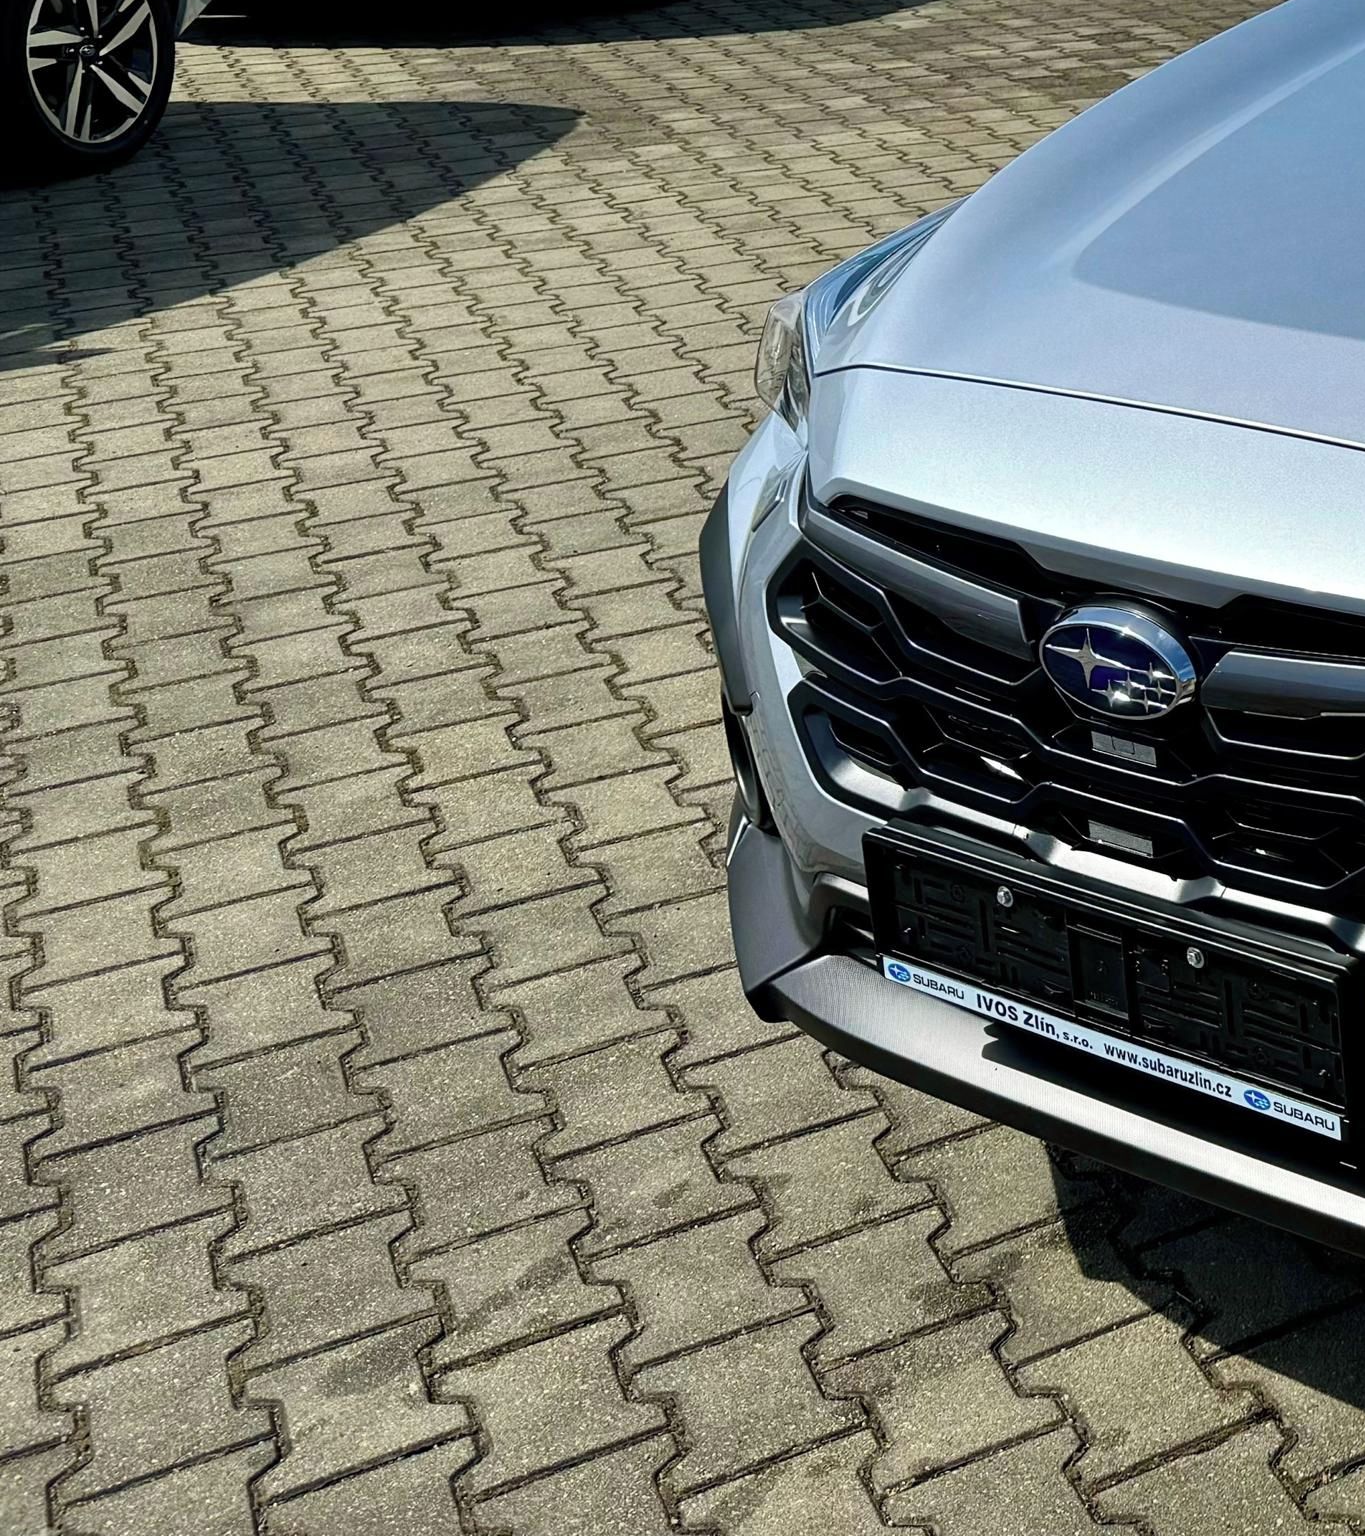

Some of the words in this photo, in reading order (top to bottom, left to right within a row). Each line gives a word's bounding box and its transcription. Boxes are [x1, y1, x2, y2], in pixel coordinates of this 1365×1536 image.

[912, 973, 965, 1000] SUBARU
[976, 993, 1019, 1022] IVOS
[1022, 1010, 1060, 1040] Zlín,
[1062, 1031, 1094, 1050] s.r.o.
[1103, 1043, 1232, 1098] www.subaruzlin.cz
[1273, 1101, 1335, 1132] SUBARU
